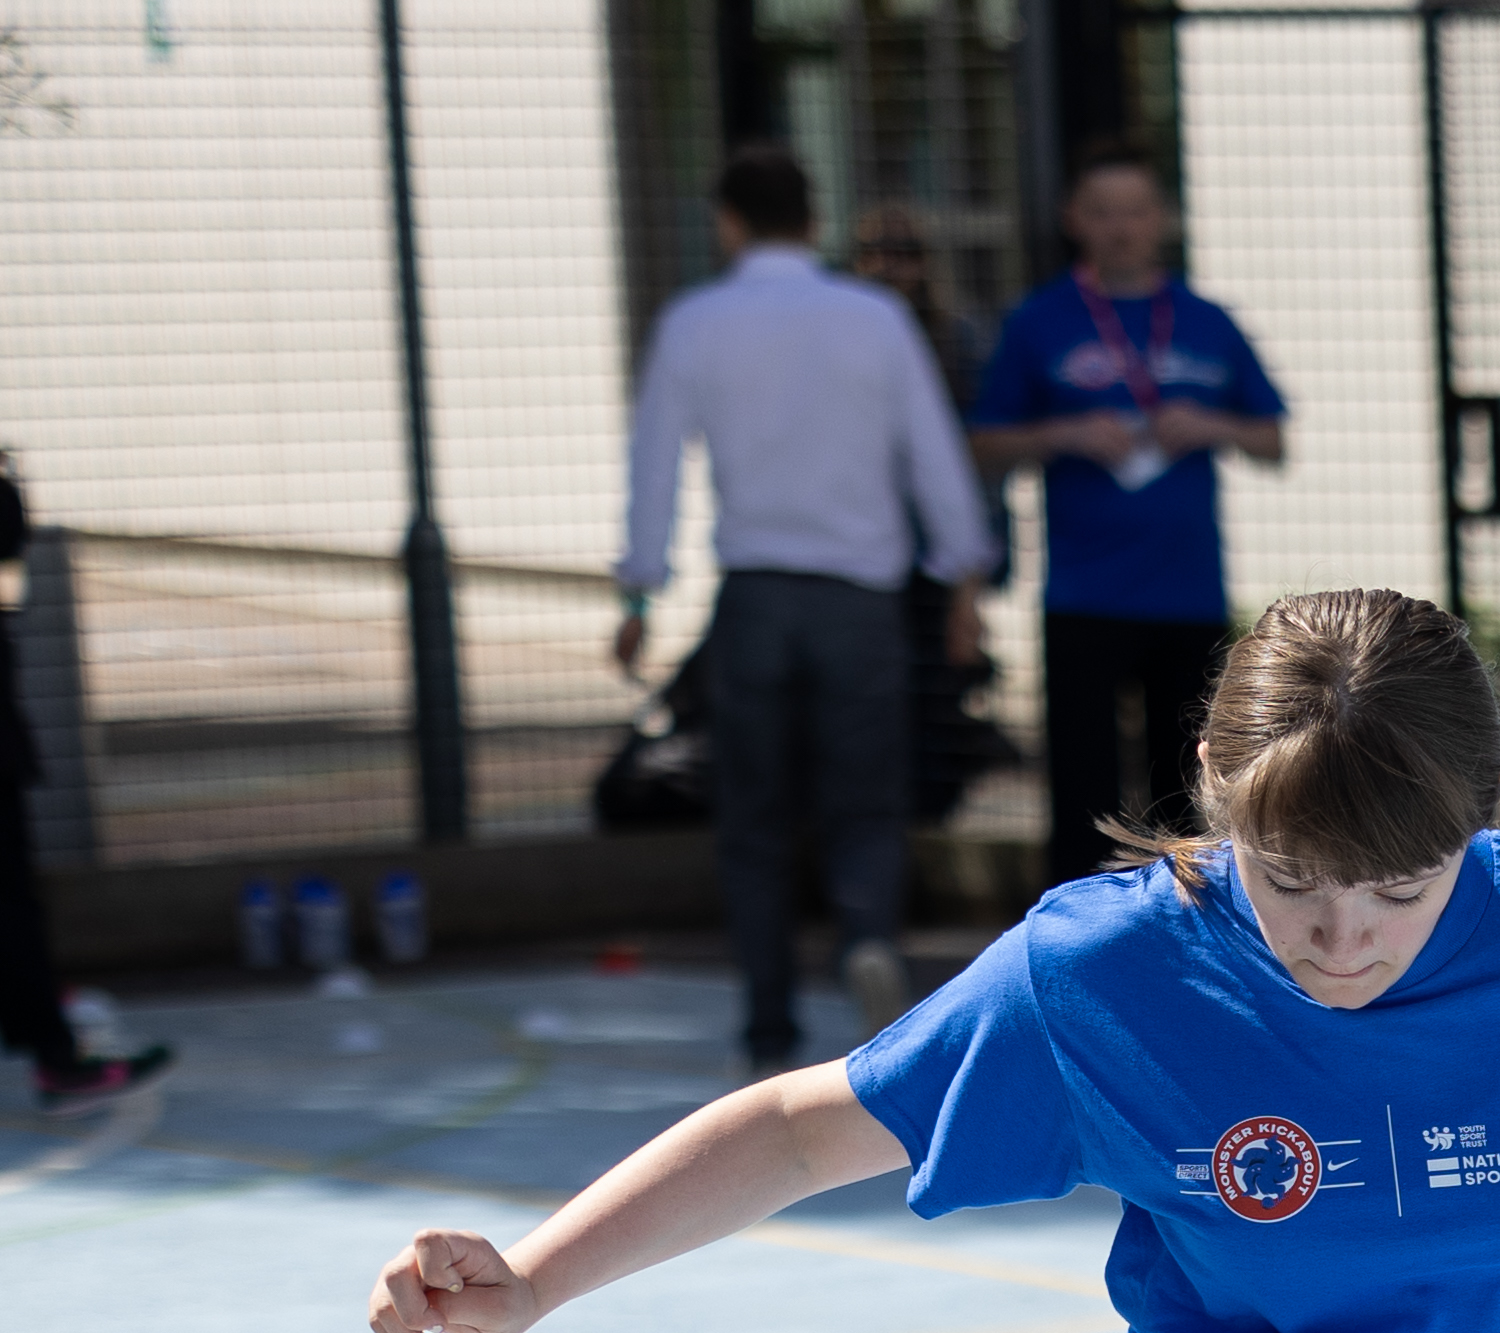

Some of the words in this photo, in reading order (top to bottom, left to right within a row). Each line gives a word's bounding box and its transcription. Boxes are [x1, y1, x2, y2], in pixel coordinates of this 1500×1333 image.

[1457, 1125, 1486, 1134] YOUTH
[1459, 1132, 1487, 1141] SPORT
[1460, 1139, 1488, 1149] TRUST
[1218, 1127, 1255, 1200] MONSTER
[1258, 1123, 1315, 1196] KICKABOUT
[1179, 1164, 1208, 1172] SPORTS
